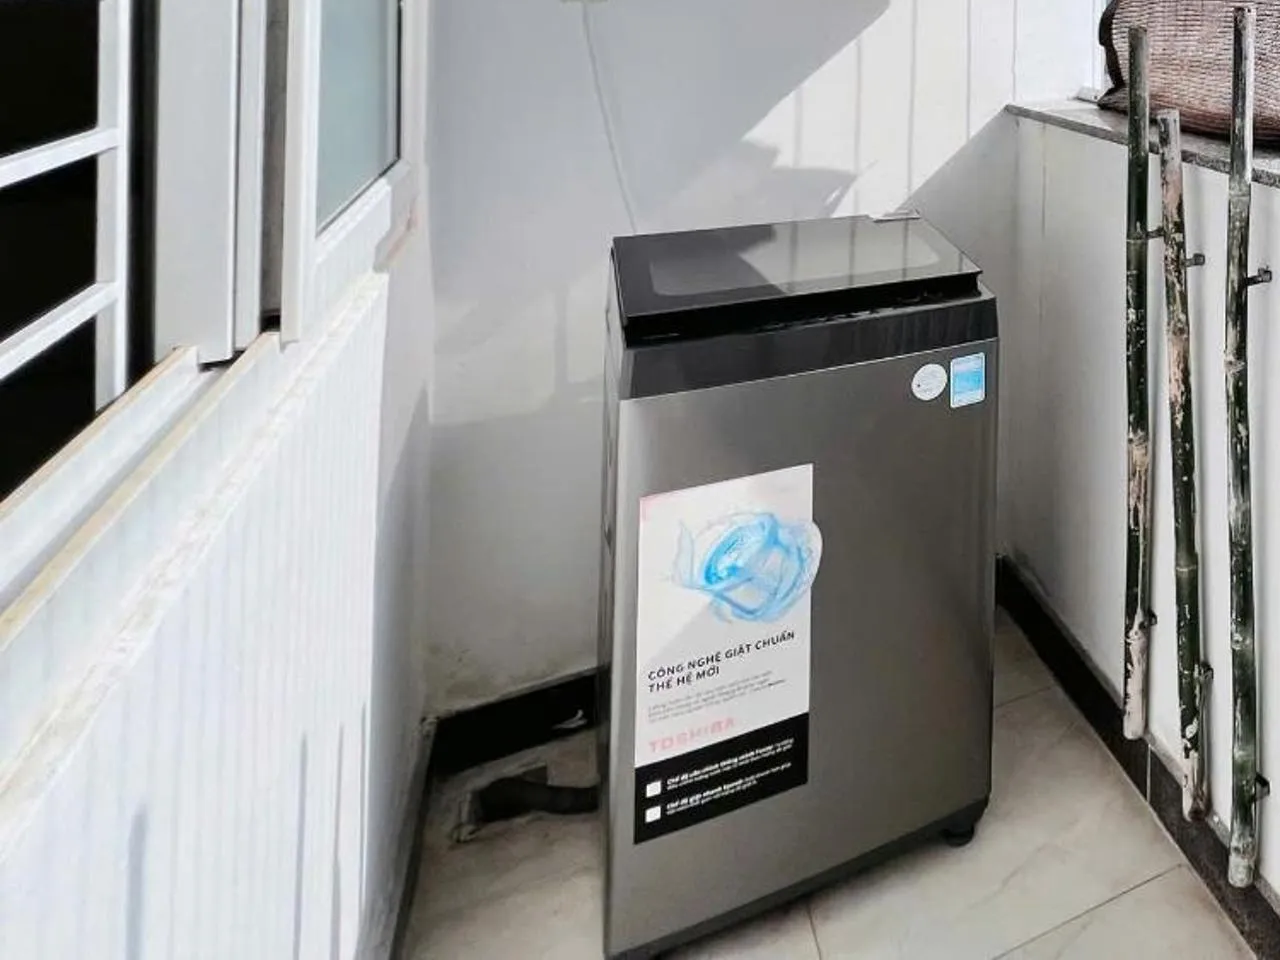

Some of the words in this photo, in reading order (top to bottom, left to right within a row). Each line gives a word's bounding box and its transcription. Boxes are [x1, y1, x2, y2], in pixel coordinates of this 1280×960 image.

[647, 663, 684, 681] CÔNG
[648, 677, 673, 693] THẾ
[677, 671, 692, 686] HỆ
[696, 665, 720, 680] MỚI
[649, 717, 735, 753] TOSHIBA
